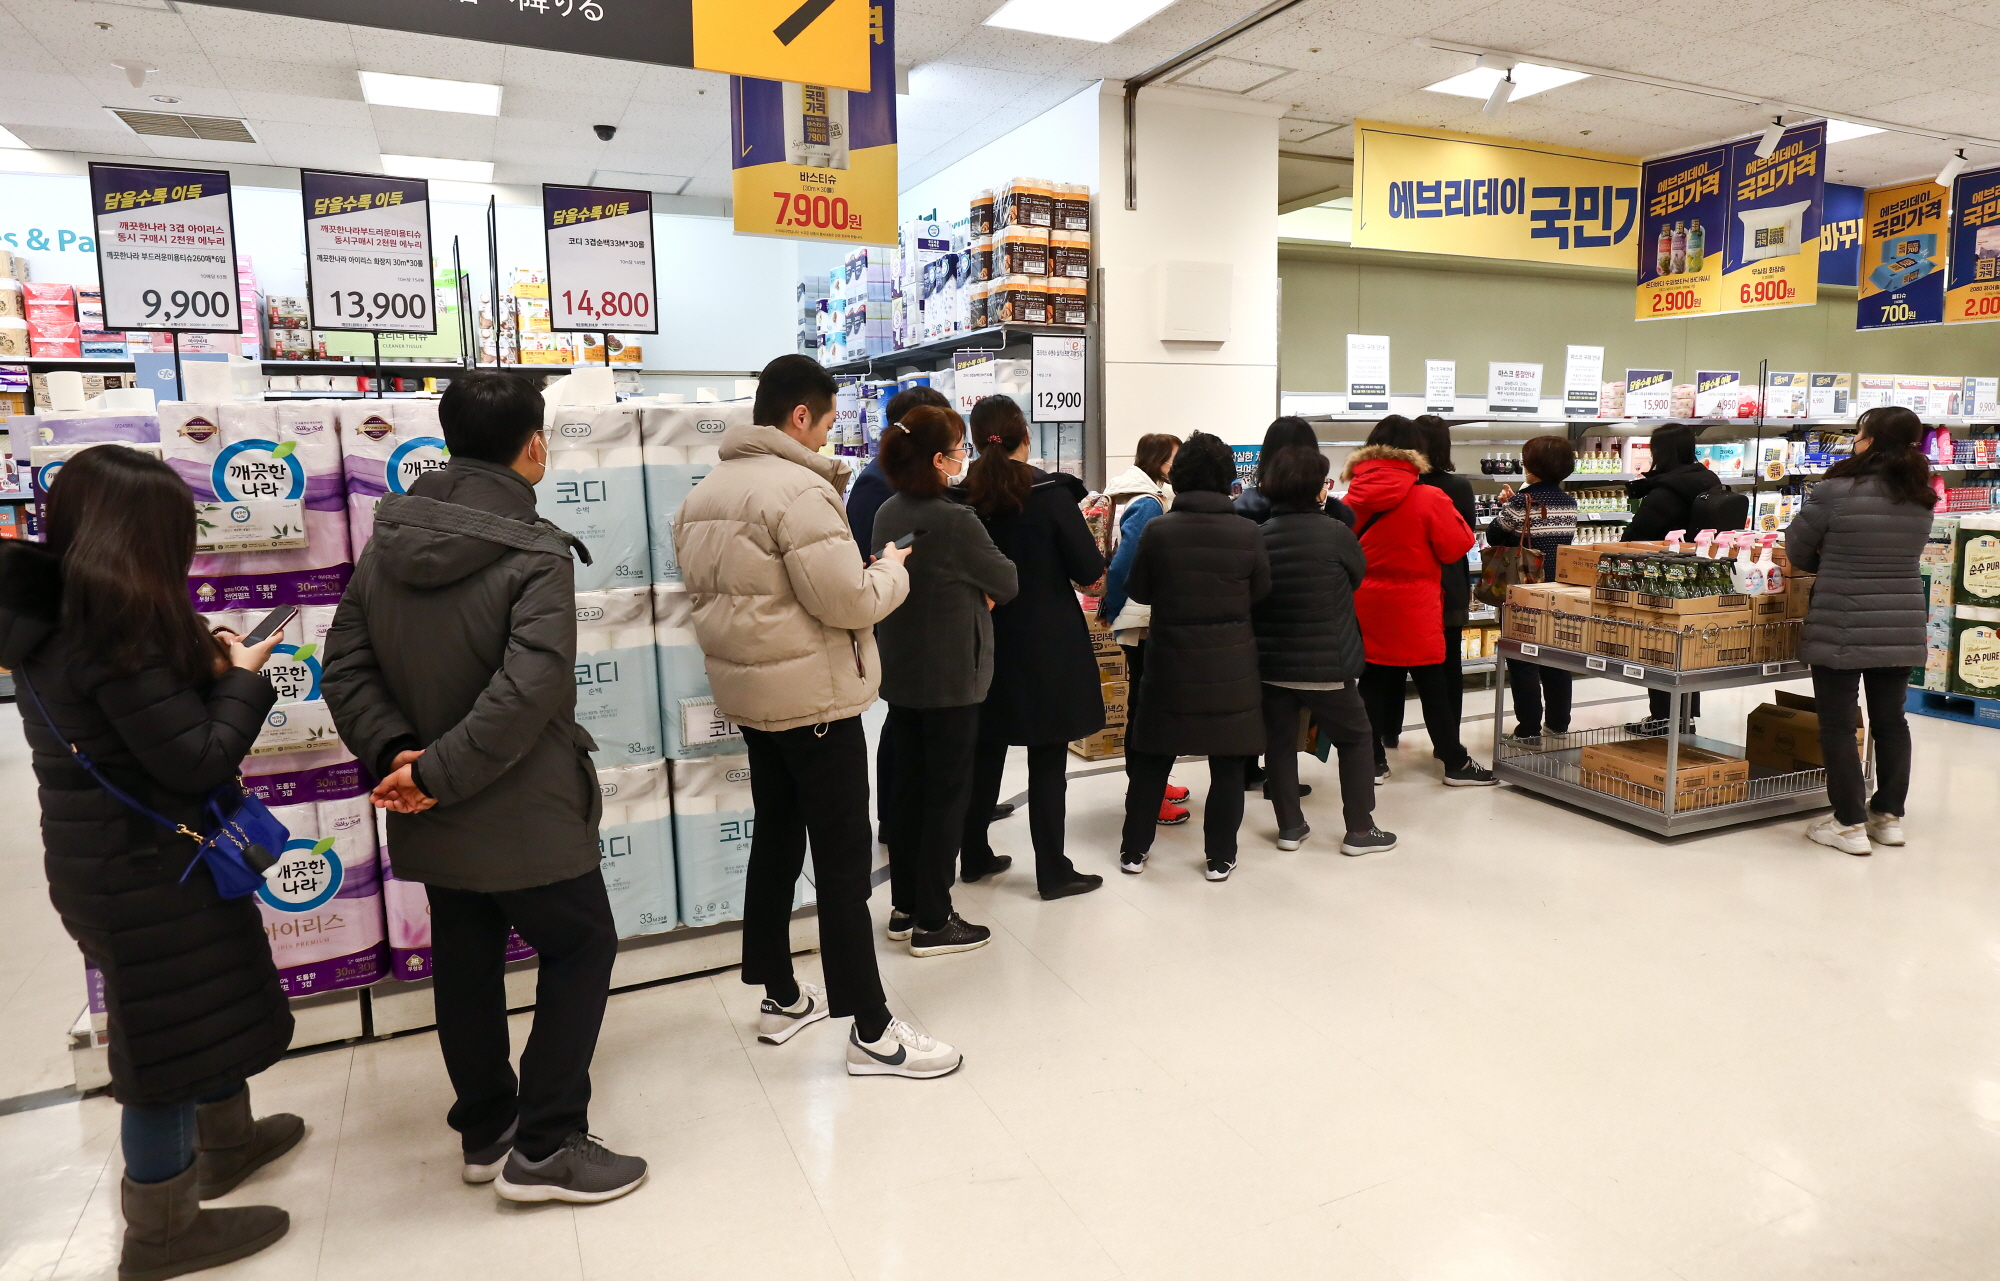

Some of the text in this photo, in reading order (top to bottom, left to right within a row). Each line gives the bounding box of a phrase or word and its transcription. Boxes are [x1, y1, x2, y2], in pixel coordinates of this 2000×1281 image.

[805, 90, 825, 103] 국민
[805, 102, 826, 115] 가격
[807, 132, 827, 143] 7900
[1745, 140, 1804, 176] 에브리데이
[799, 171, 837, 185] 바스티슈
[1657, 161, 1709, 194] 에브리데이
[1737, 150, 1817, 201] 국민가격
[104, 184, 203, 211] 담을수록 이득
[1388, 177, 1526, 219] 에브리데이
[1649, 170, 1720, 217] 국민가격
[314, 191, 404, 215] 담을수록 이득
[1880, 190, 1931, 218] 에브리데이
[553, 201, 630, 226] 담을수록 이득
[773, 191, 863, 231] 7,900원
[1872, 199, 1942, 239] 국민가격
[119, 221, 225, 235] 깨끗한나라 3겹 아이리스
[320, 224, 422, 239] 깨끗한나라부드러운미용티슈
[26, 228, 51, 251] &
[117, 233, 226, 246] 동시 구매시 2천원 에누리
[334, 236, 423, 249] 동시구매시 2천원 에누리
[568, 237, 583, 246] 코디
[106, 251, 140, 261] 깨끗한나라
[316, 254, 347, 264] 깨끗한나라
[348, 256, 373, 265] 아이리스
[373, 257, 392, 267] 화장지
[1979, 270, 1993, 278] 가격
[1980, 263, 1993, 271] 국민
[1740, 279, 1796, 304] 6,900원
[142, 289, 230, 322] 9,900
[330, 290, 426, 323] 13,900
[562, 289, 649, 321] 14,800
[1652, 290, 1702, 313] 2,900원
[1880, 303, 1917, 323] 700원
[1497, 369, 1514, 378] 마스크
[1629, 376, 1652, 391] 담을수록
[1037, 391, 1082, 411] 12,900
[1643, 399, 1669, 411] 15,900
[1716, 399, 1736, 411] 4,950
[1979, 402, 1996, 412] 9,900
[229, 462, 286, 481] 깨끗한
[242, 482, 279, 498] 나라
[556, 480, 607, 504] 코디
[575, 506, 590, 515] 순백
[1969, 563, 1986, 576] 순수
[255, 583, 277, 592] 도톰한
[297, 582, 318, 592] 30m
[224, 592, 273, 601] 천연펄프 3겹
[1964, 651, 2000, 666] 순수 PURE
[574, 660, 619, 686] 코디
[275, 782, 296, 790] 도톰한
[315, 778, 337, 789] 30m
[282, 789, 293, 797] 3겹
[349, 818, 362, 826] Soft
[282, 878, 318, 895] 나라
[263, 913, 346, 941] 아이리스
[295, 937, 331, 948] PREMIUM
[295, 972, 317, 983] 도톰한
[335, 967, 356, 978] 30m
[301, 980, 312, 988] 3겹
